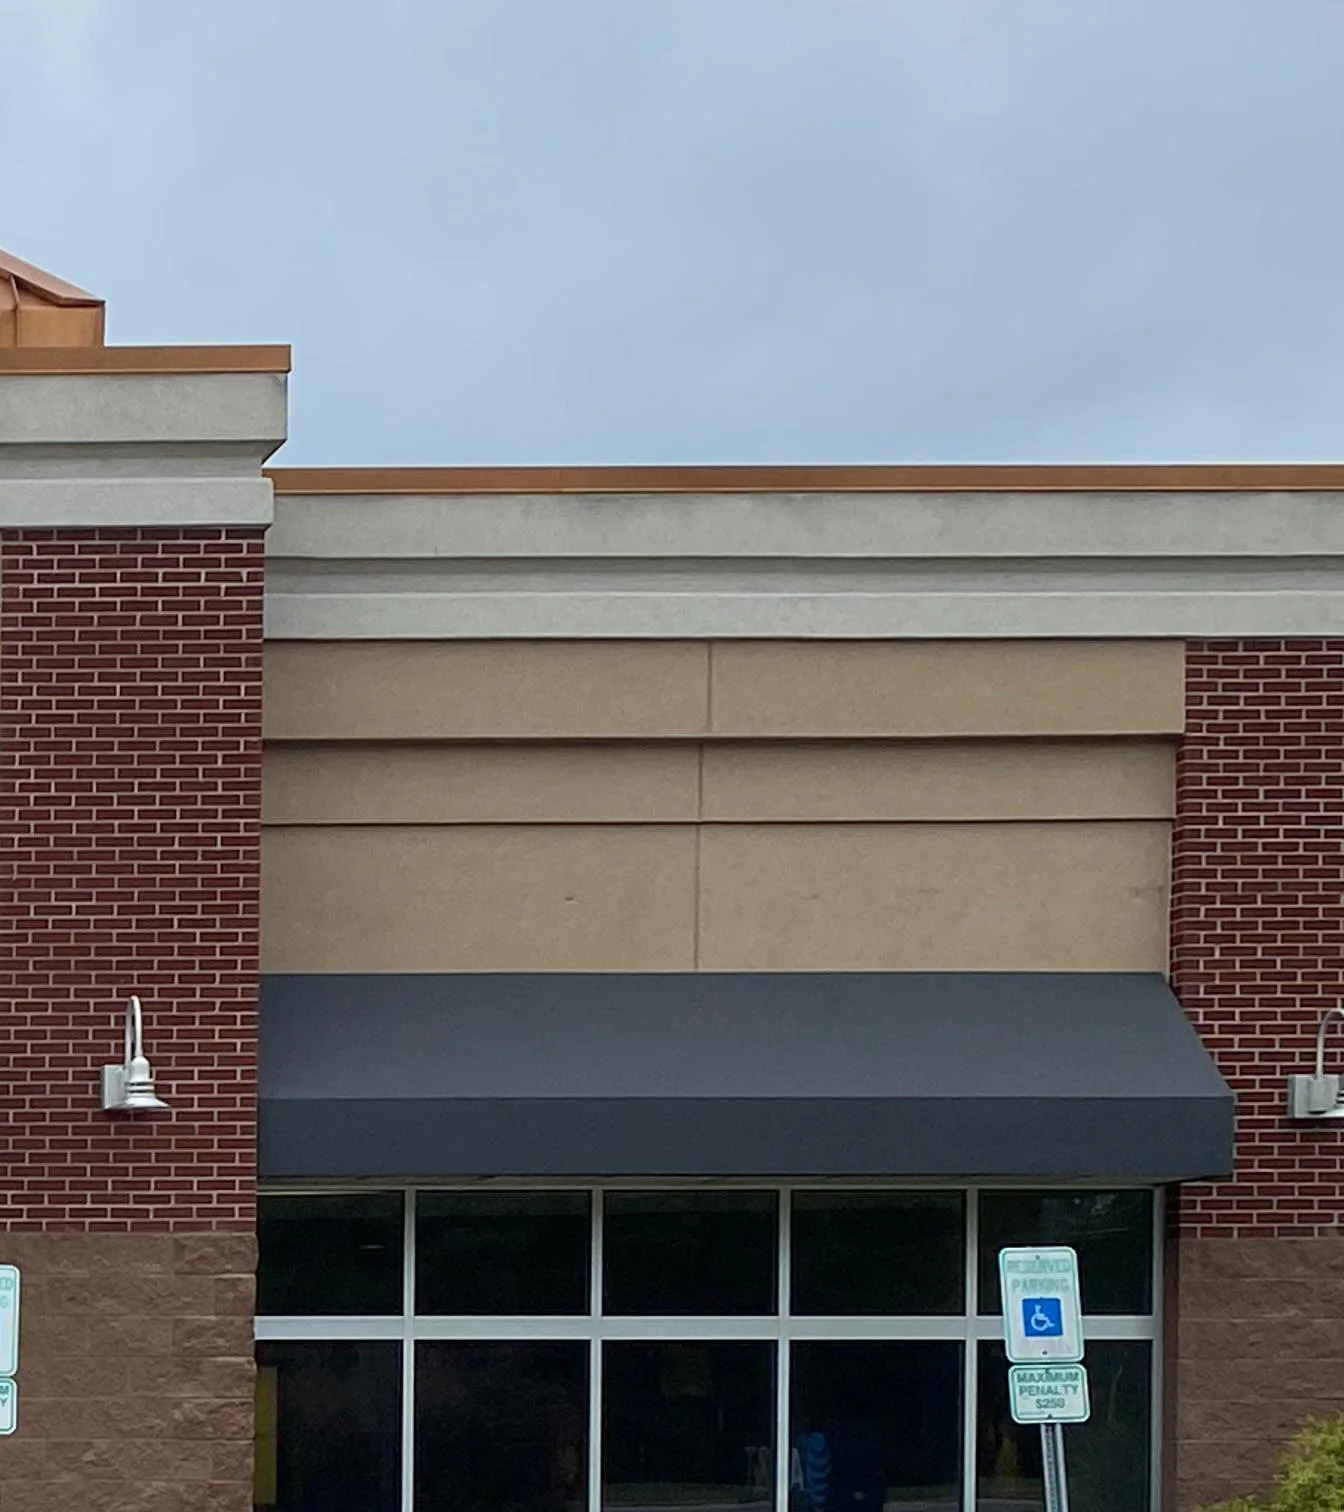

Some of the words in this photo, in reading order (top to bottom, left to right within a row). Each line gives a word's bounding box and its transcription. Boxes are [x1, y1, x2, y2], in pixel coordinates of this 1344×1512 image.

[1007, 1259, 1072, 1273] RESERVED
[1012, 1278, 1070, 1293] PARKING
[1016, 1372, 1080, 1383] MAXIMUM
[1018, 1384, 1079, 1396] PENALTY
[1035, 1398, 1065, 1409] $250
